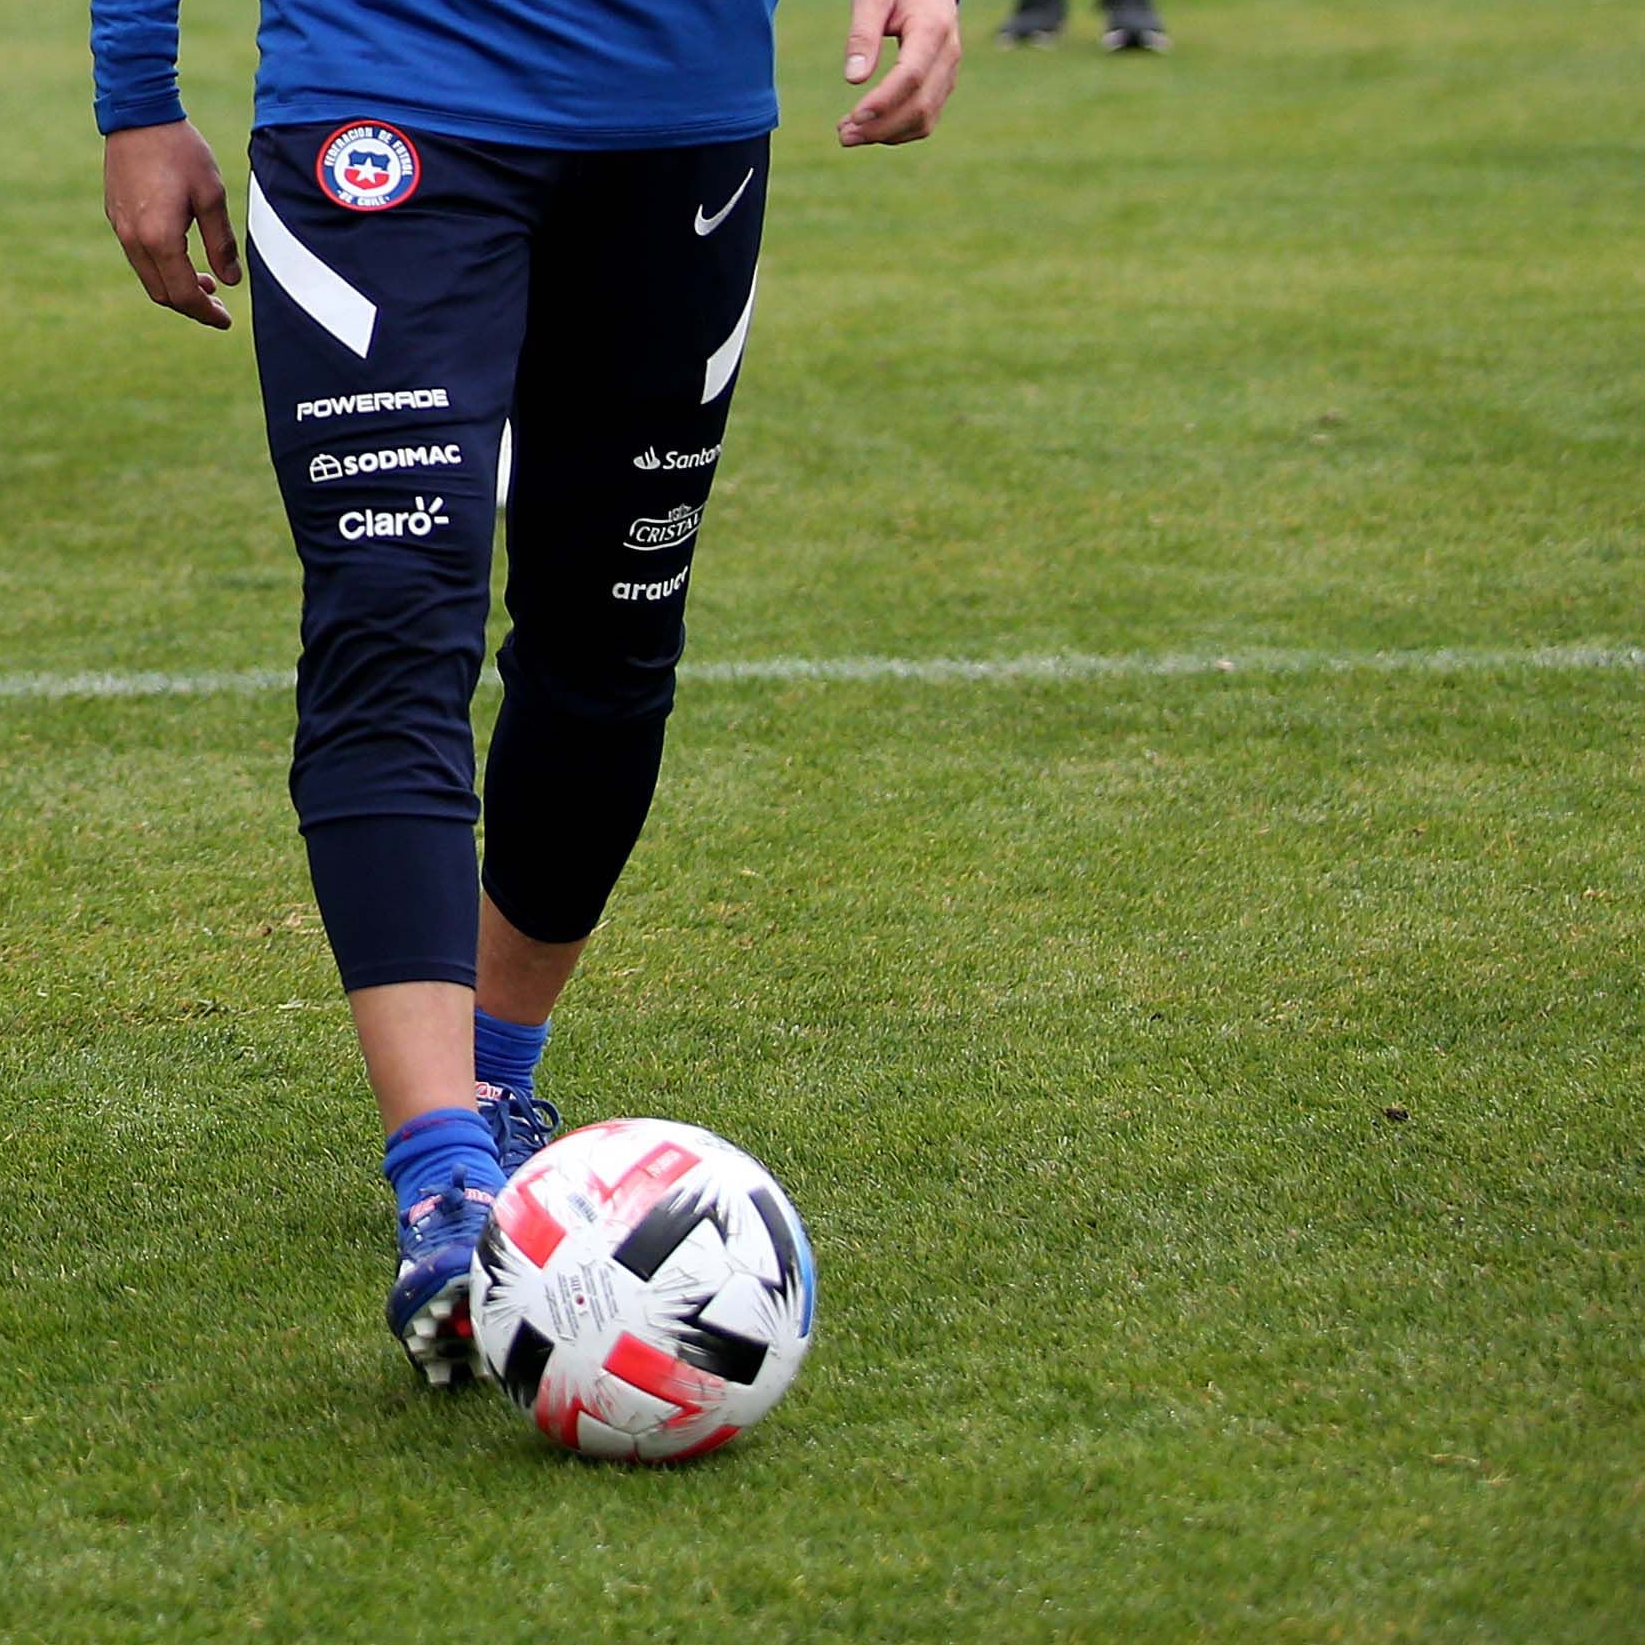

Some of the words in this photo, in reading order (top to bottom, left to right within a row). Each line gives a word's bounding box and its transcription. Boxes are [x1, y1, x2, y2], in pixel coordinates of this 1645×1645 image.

[296, 388, 450, 421] POWERADE
[343, 444, 462, 476] SODIMAC
[338, 509, 433, 540] Claro
